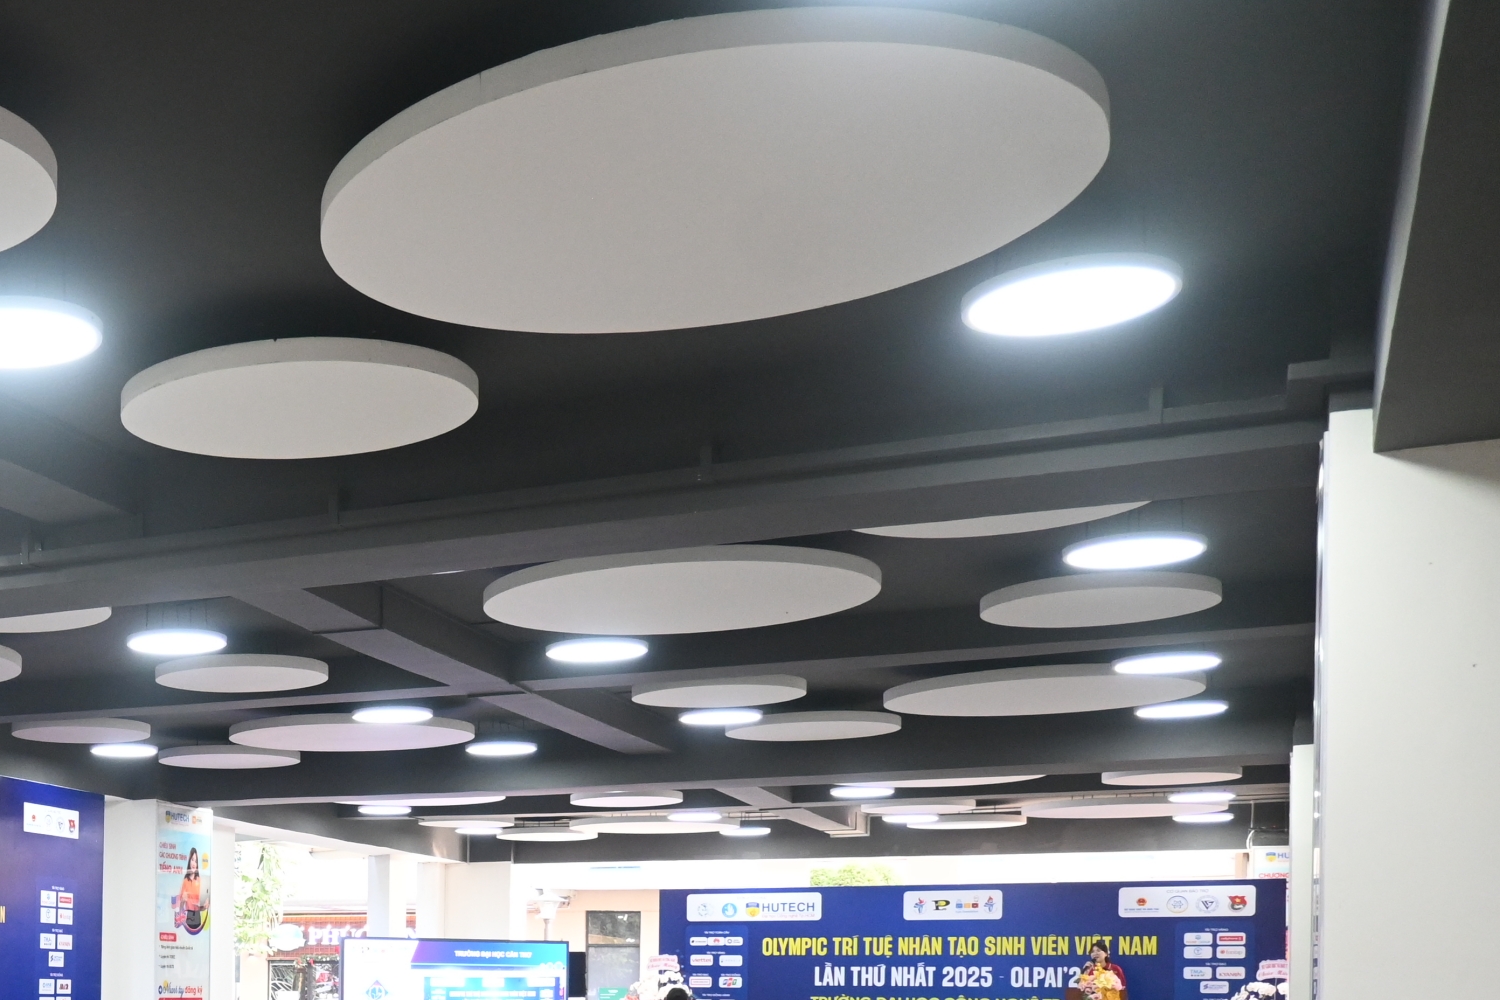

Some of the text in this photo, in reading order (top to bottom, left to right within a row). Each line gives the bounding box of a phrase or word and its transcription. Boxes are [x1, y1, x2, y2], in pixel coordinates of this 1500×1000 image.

[171, 811, 190, 823] HUTECH
[762, 902, 815, 912] HUTECH
[762, 933, 1158, 958] OLYMPIC TRÍ TUỆ NHÂN TẠO SINH VIÊN NAM
[814, 961, 993, 988] LẦN THỨ NHẤT 2025
